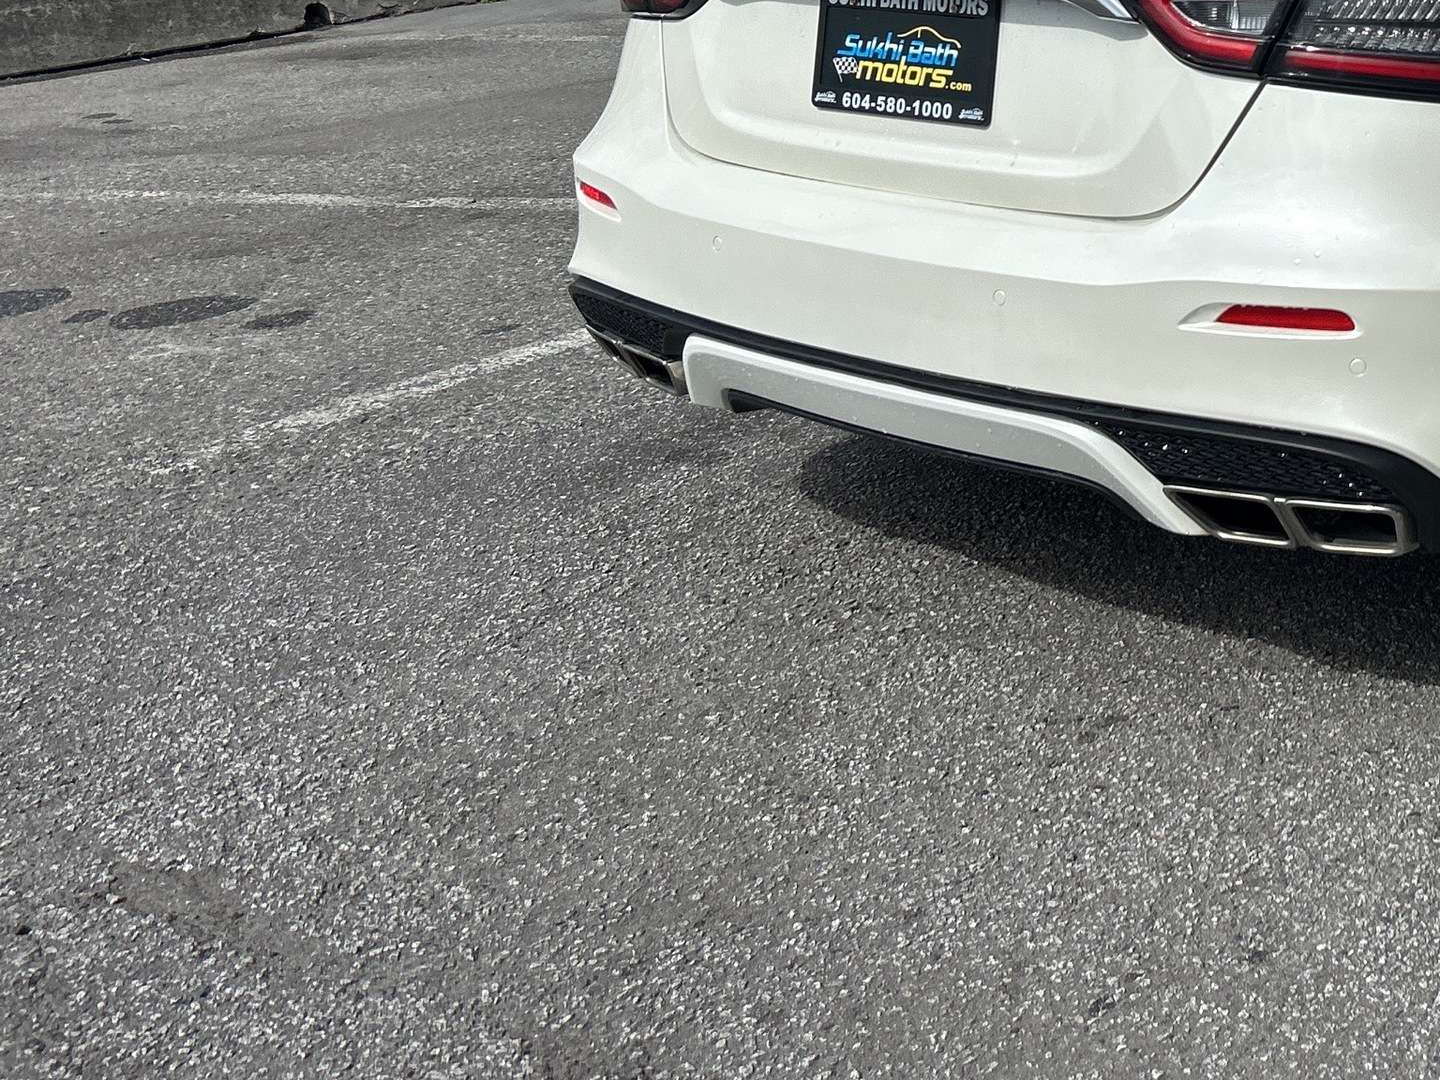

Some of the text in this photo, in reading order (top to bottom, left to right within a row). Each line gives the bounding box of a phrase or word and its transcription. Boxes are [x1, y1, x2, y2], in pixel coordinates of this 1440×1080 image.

[836, 31, 959, 67] Sukhi Bath
[841, 91, 953, 120] 604-580-1000
